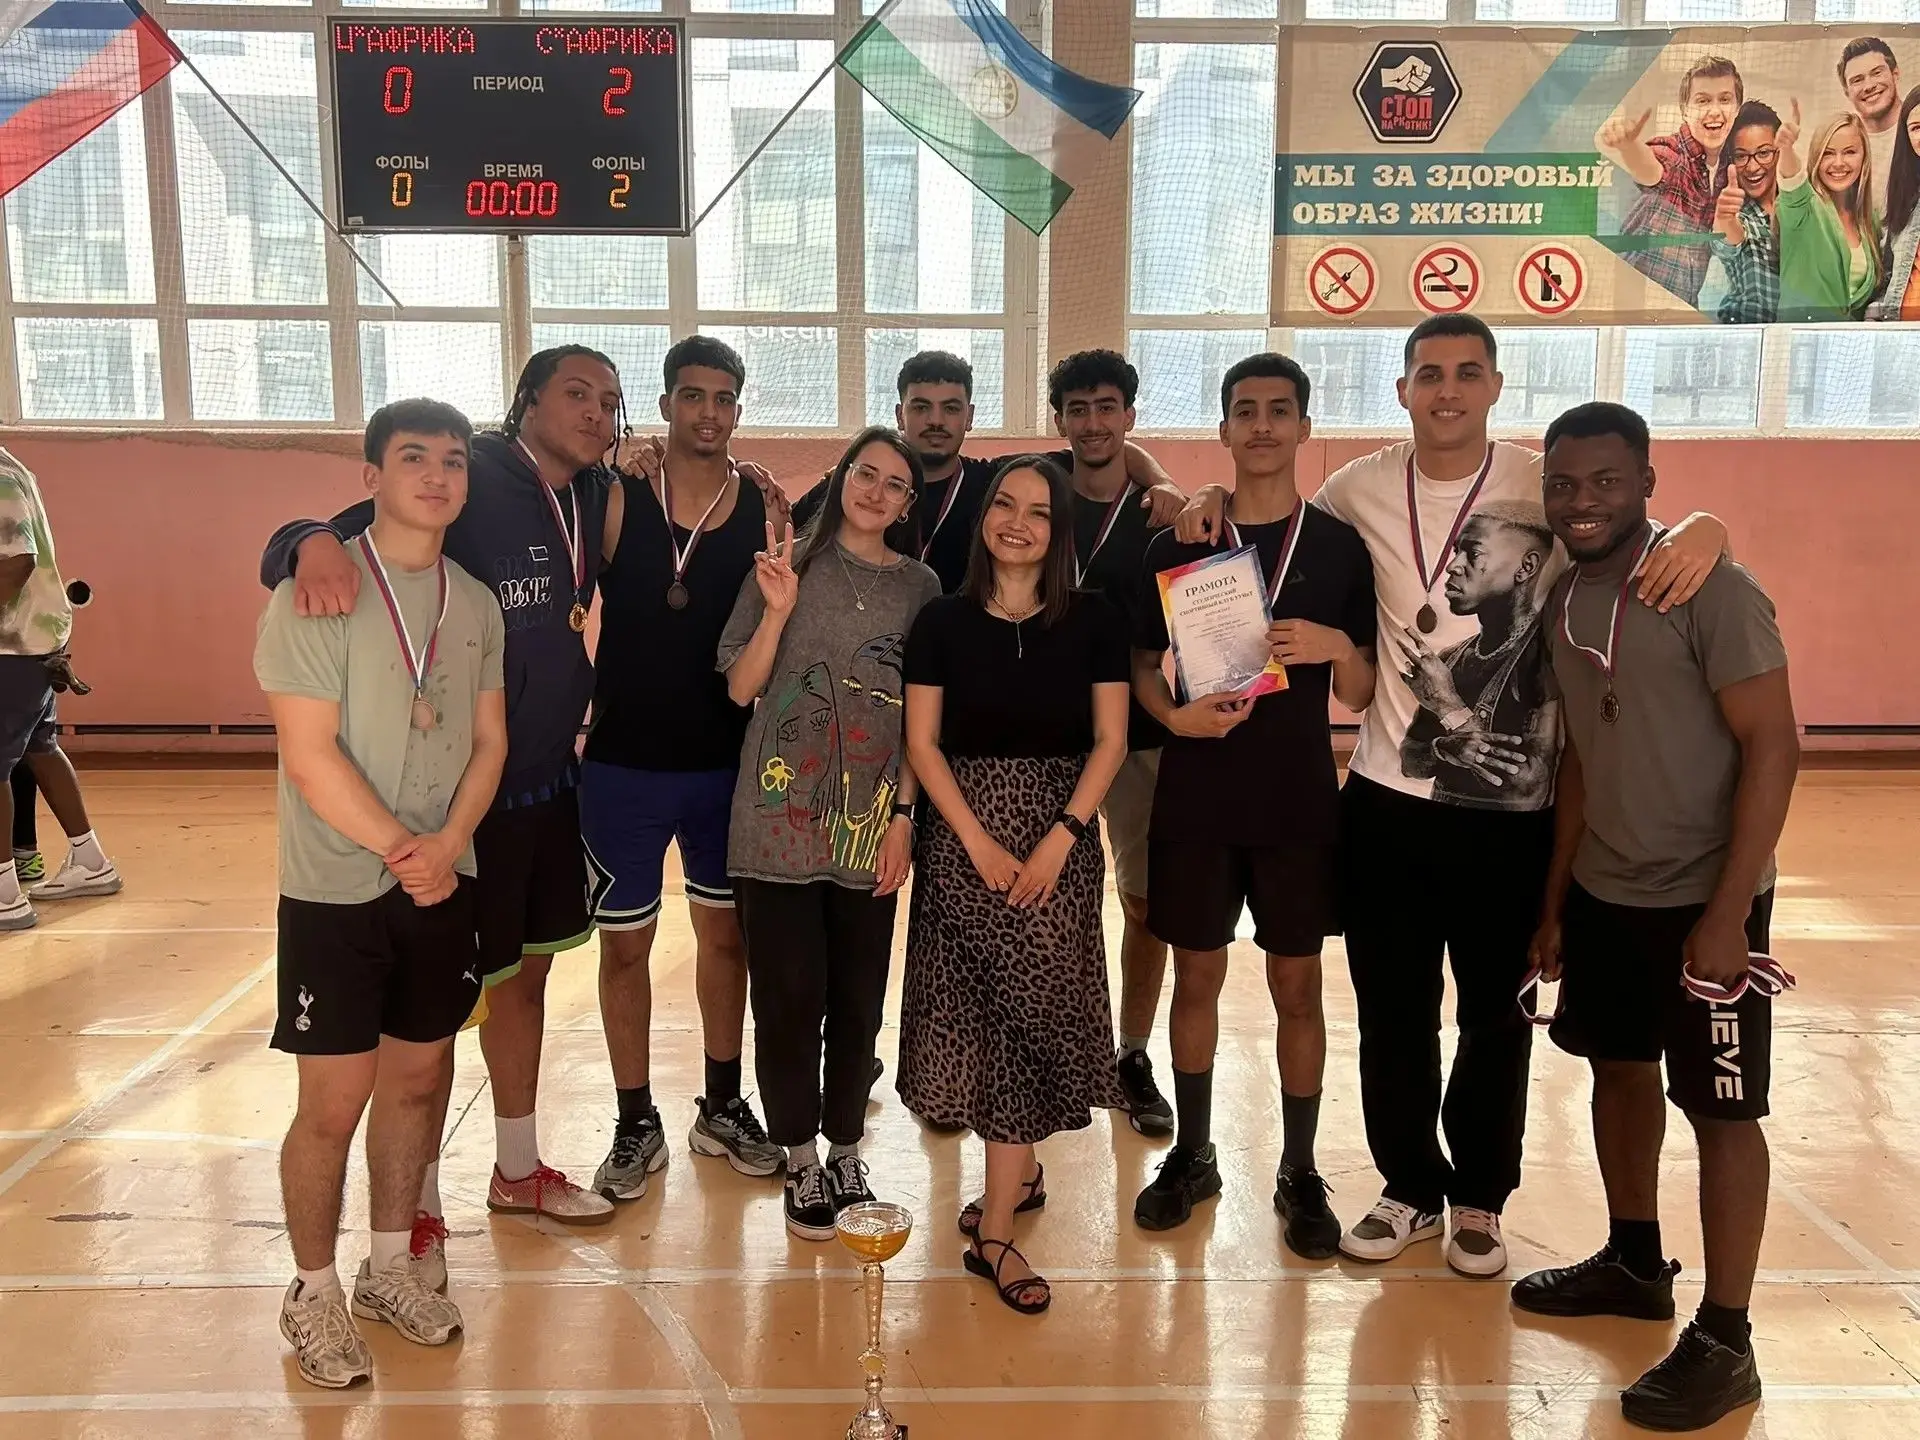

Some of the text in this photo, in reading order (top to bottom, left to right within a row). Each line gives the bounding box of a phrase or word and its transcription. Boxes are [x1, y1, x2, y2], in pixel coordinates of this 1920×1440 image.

[383, 65, 414, 114] 0
[473, 76, 544, 92] ПЕРИОД
[602, 67, 633, 115] 2
[1381, 94, 1433, 119] СТОП
[375, 156, 429, 171] ФОЛЫ
[484, 164, 543, 178] ВРЕМЯ
[592, 157, 646, 171] ФОЛЫ
[1293, 160, 1614, 190] МЫ ЗА ЗДОРОВЫЙ
[392, 172, 413, 207] 0
[466, 180, 559, 216] 00:00
[609, 173, 631, 208] 2
[1292, 202, 1544, 226] ОБРАЗ ЖИЗНИ!
[1185, 575, 1237, 597] ГРАМОТА
